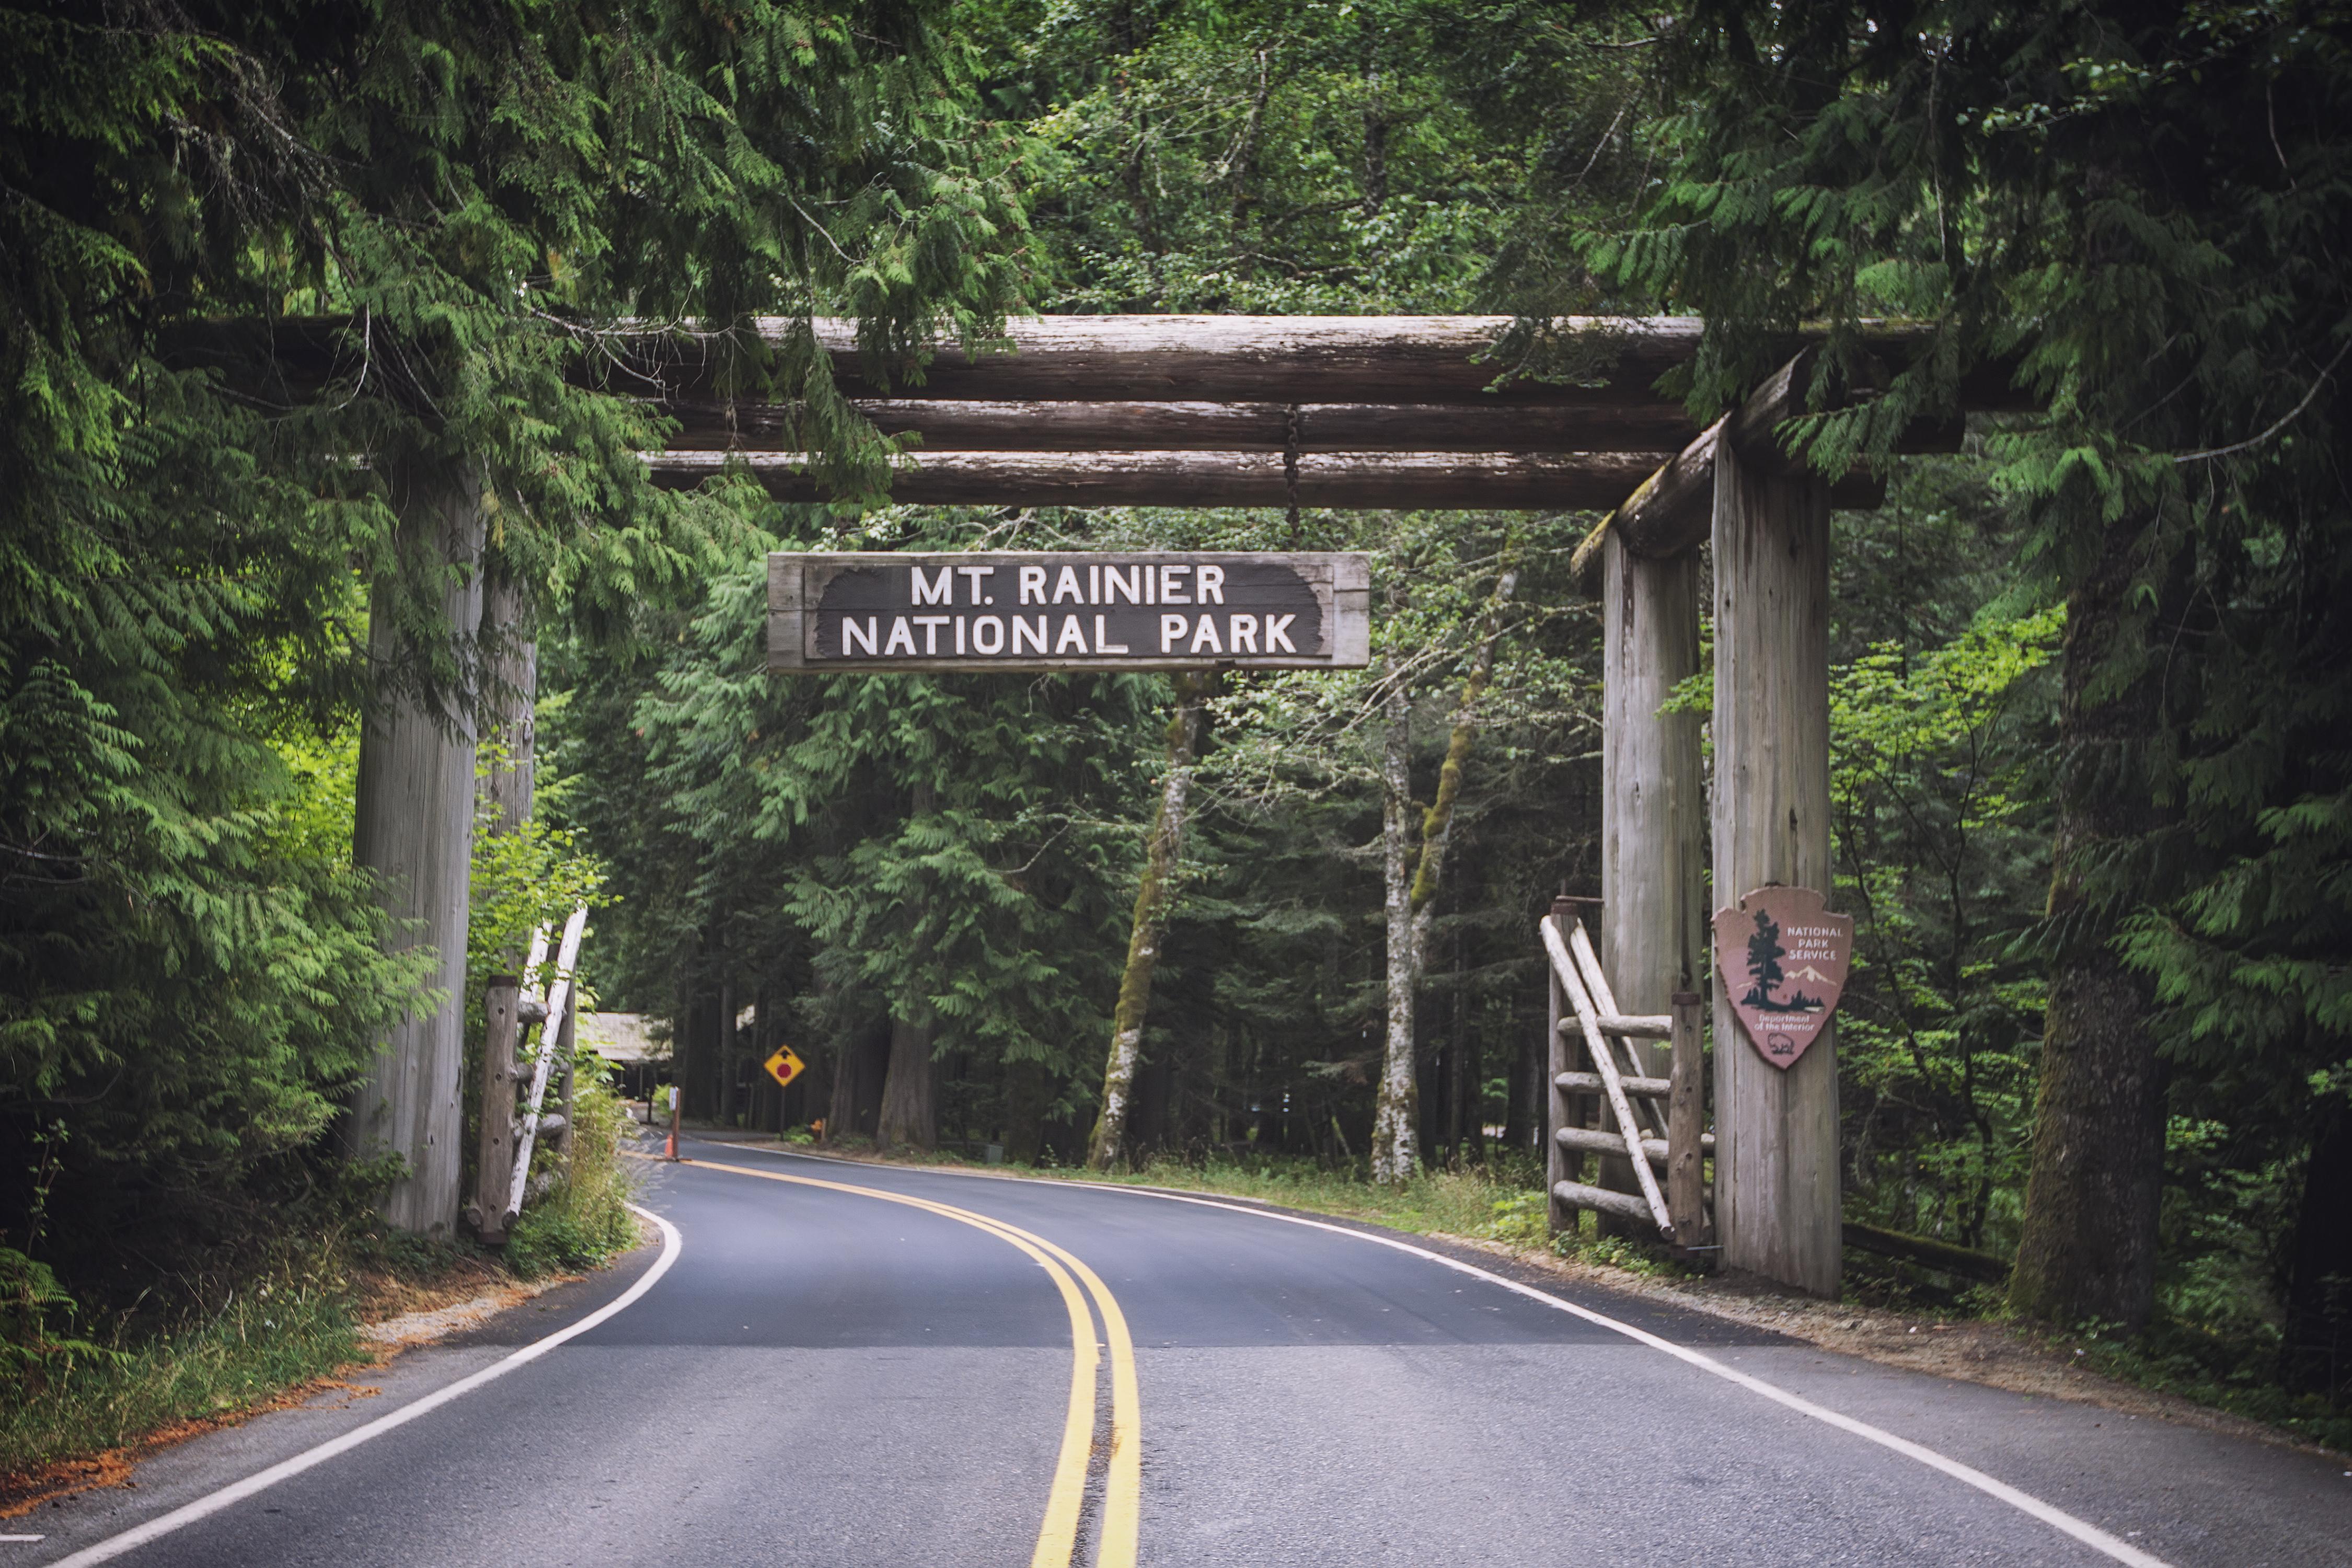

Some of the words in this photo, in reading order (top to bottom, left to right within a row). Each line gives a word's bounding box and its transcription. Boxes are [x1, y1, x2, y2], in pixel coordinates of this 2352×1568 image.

[911, 566, 994, 605] MT.
[1019, 565, 1225, 605] RAINIER
[842, 614, 1129, 655] NATIONAL
[1161, 614, 1297, 653] PARK
[1787, 927, 1842, 938] NATIONAL
[1798, 939, 1829, 949] PARK
[1789, 950, 1837, 961] SERVICE
[1759, 1014, 1809, 1023] Department
[1754, 1022, 1763, 1031] of
[1781, 1023, 1815, 1031] Interior
